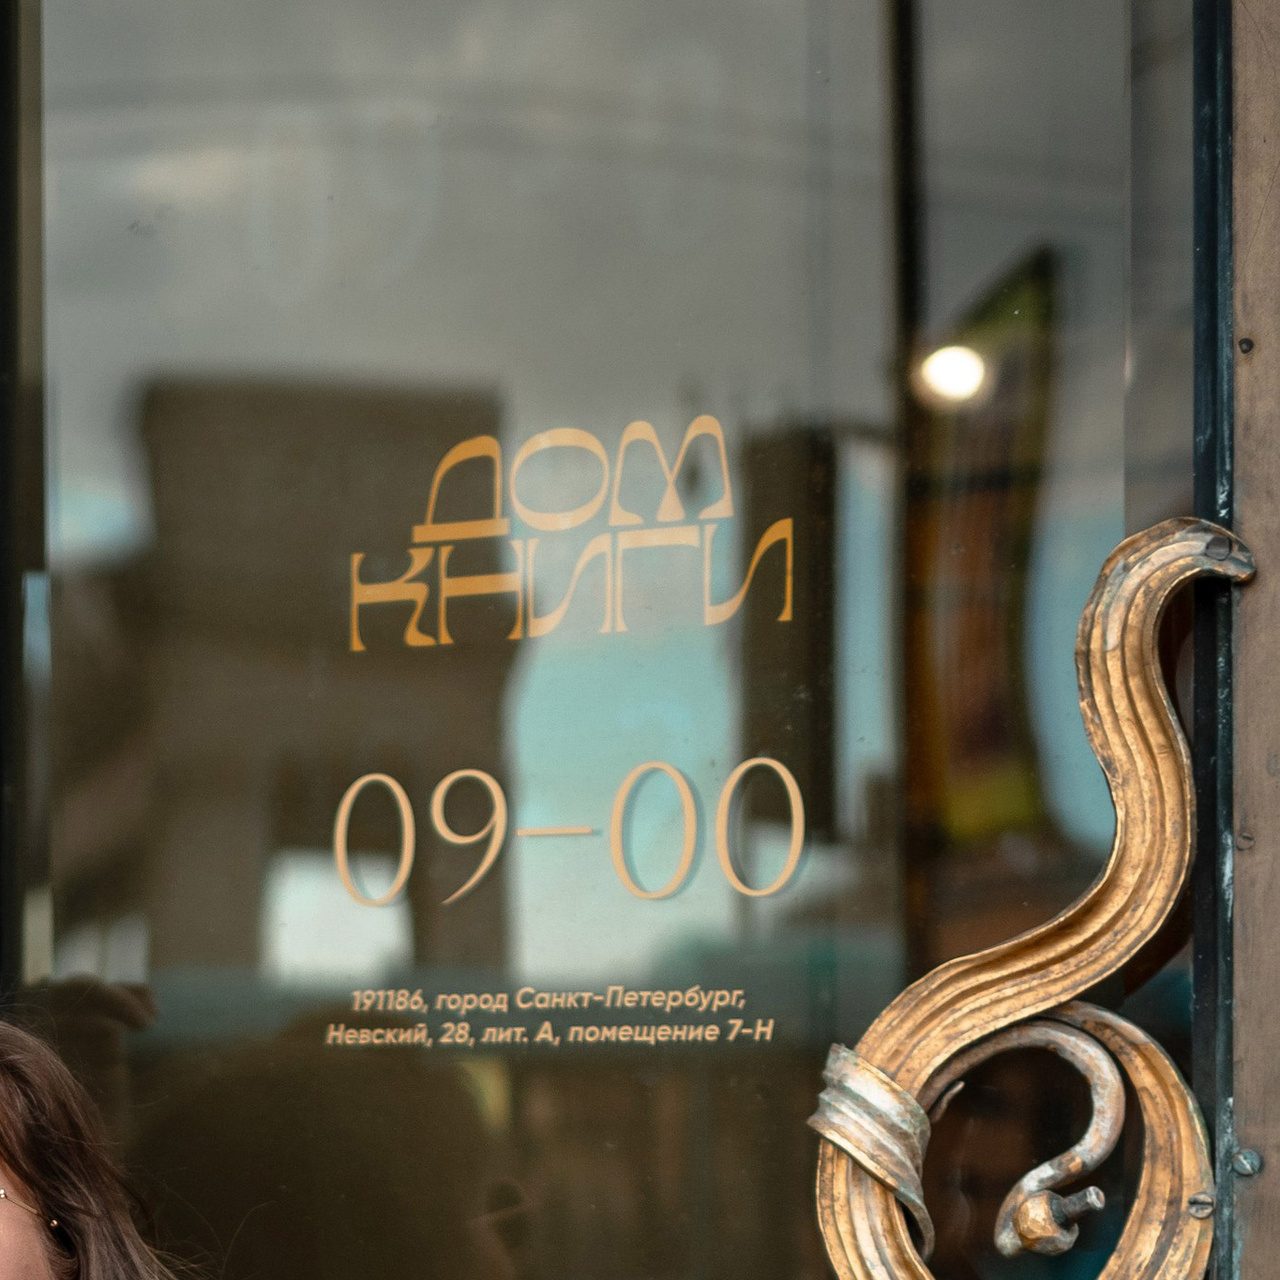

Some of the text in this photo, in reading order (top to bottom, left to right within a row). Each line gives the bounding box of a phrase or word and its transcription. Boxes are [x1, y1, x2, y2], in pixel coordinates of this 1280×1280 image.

[412, 415, 734, 544] ДОМ
[350, 518, 793, 651] КНИГИ
[326, 1018, 774, 1047] Невский, 28, лит. А, помещение 7-Н
[352, 985, 746, 1017] 191186, город Санкт-Петербург,
